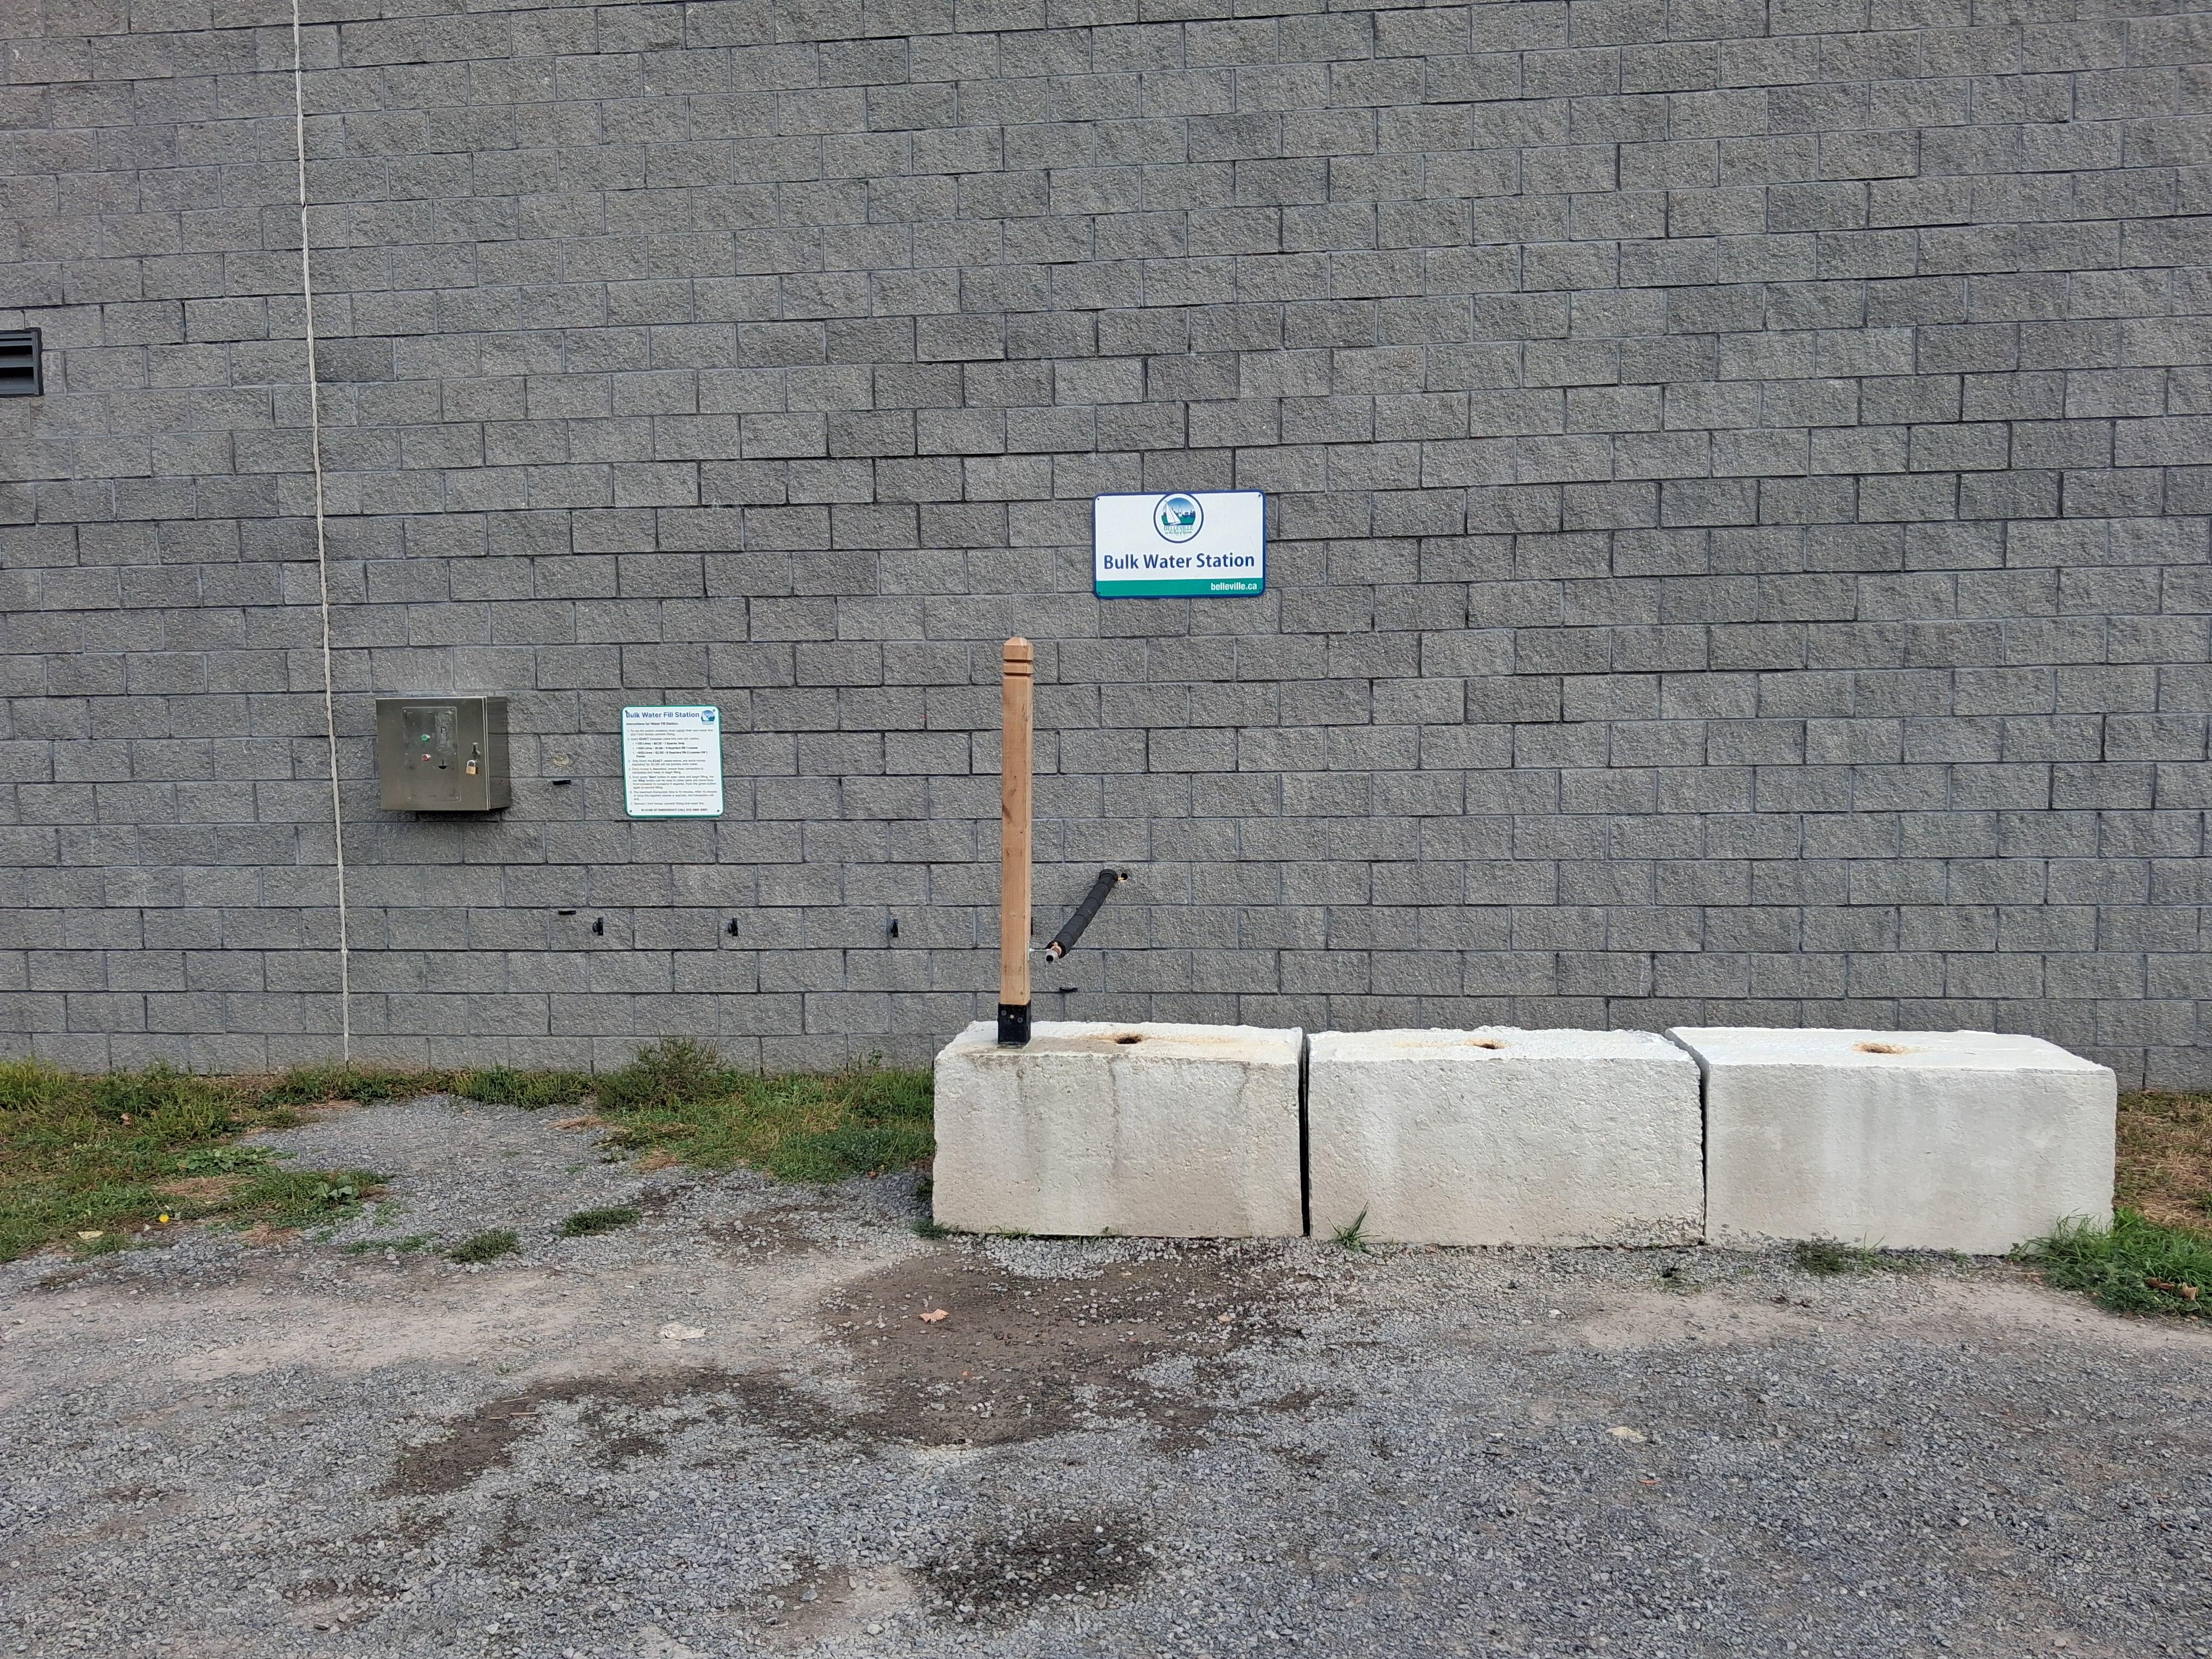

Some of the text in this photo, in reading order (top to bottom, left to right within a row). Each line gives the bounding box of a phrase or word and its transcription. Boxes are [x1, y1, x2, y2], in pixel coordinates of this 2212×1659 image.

[1104, 552, 1255, 569] Bulk Water Station
[1211, 582, 1257, 590] belleville.ca
